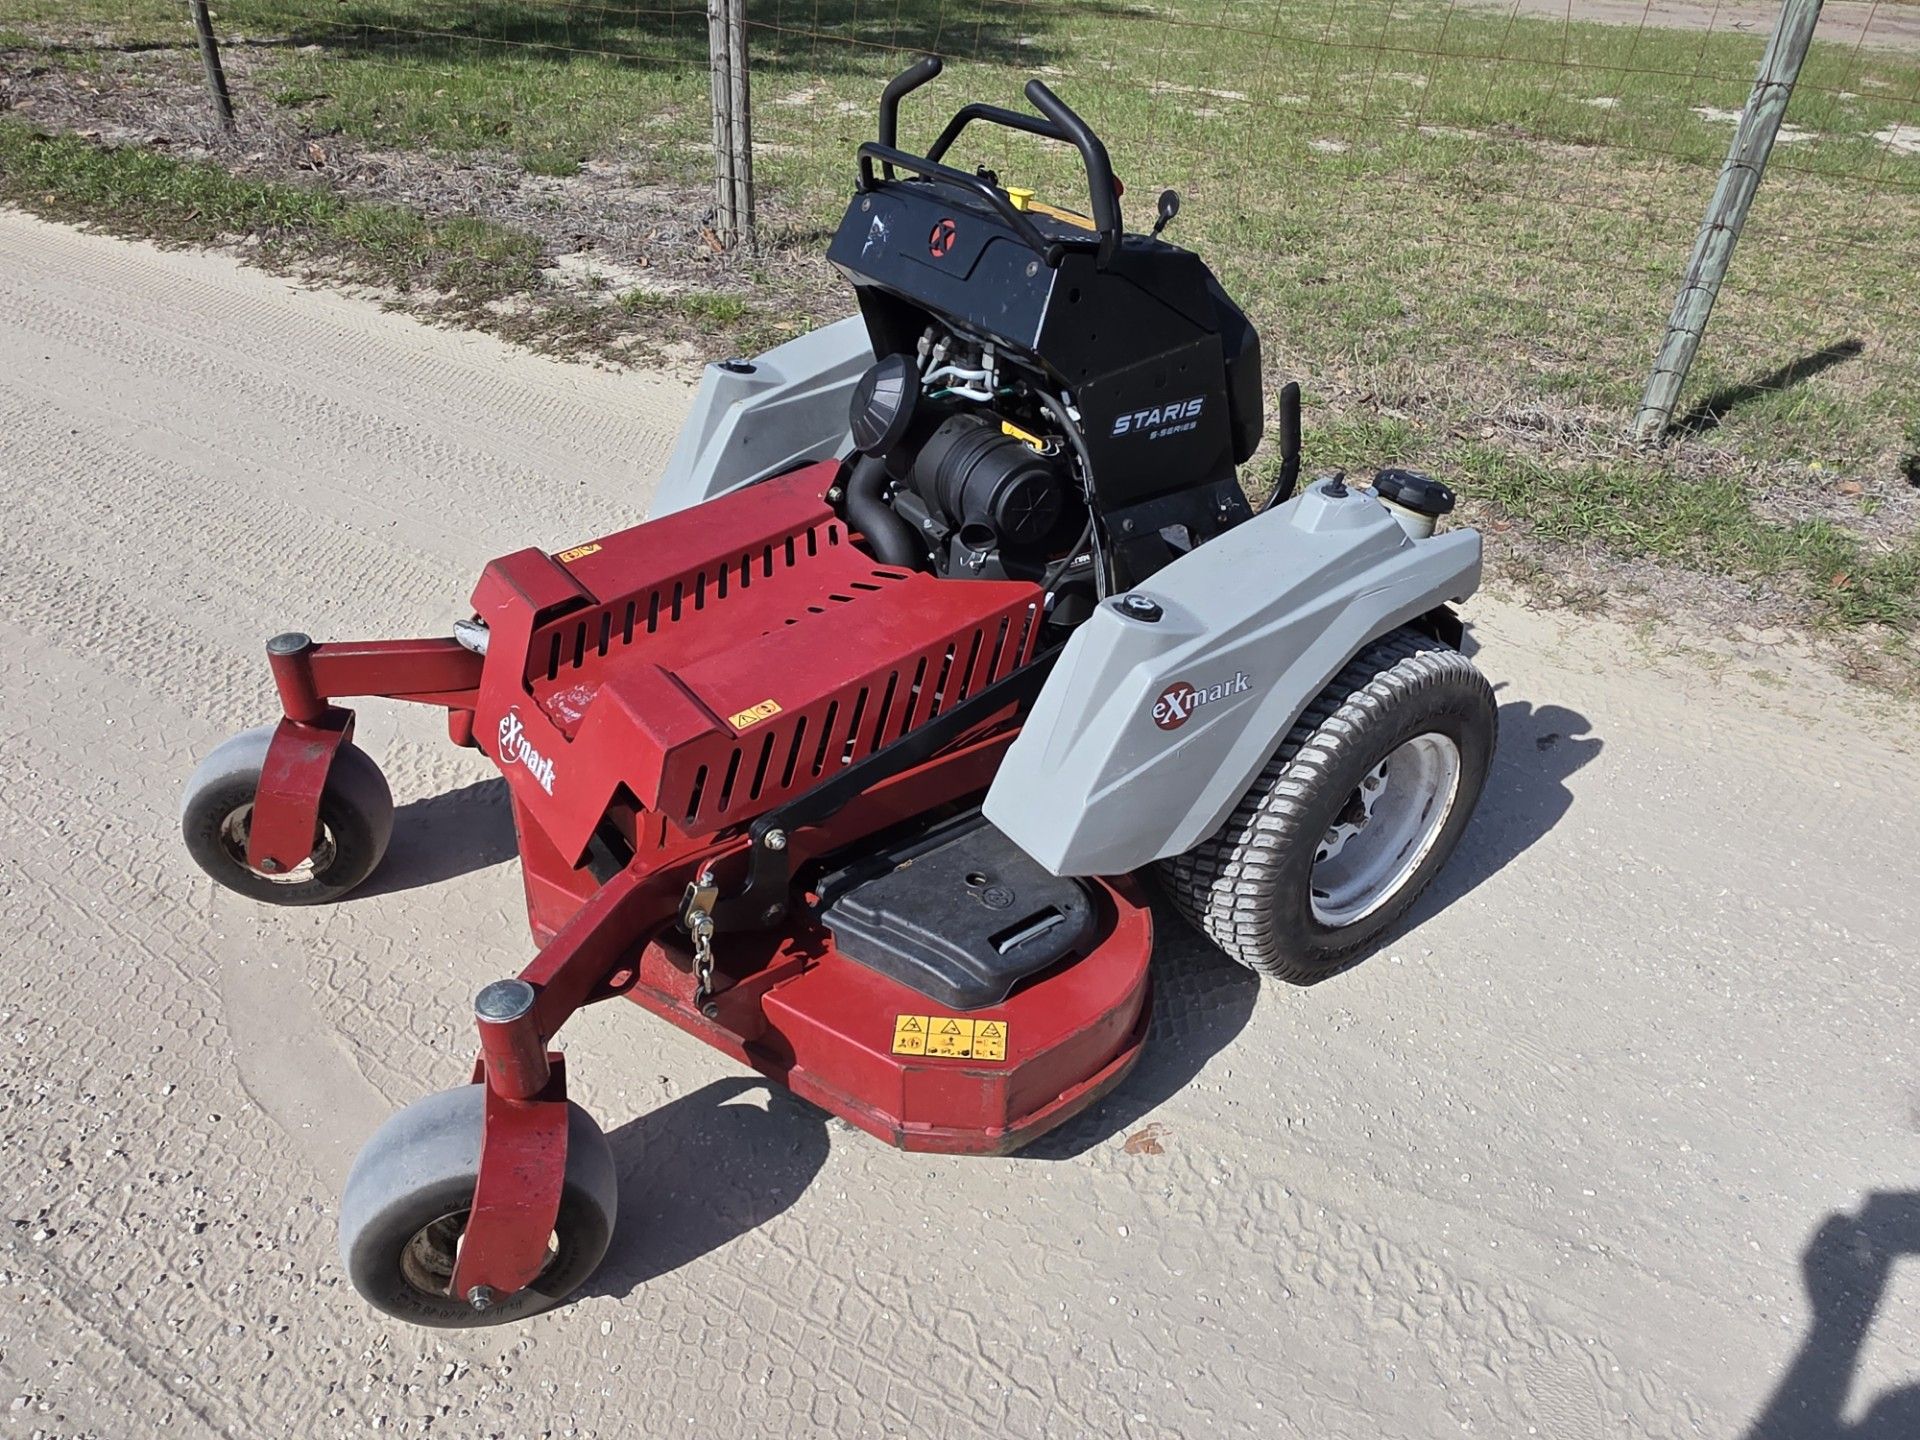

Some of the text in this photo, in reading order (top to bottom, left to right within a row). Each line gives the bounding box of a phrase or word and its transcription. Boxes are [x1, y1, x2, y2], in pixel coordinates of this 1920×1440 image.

[1112, 398, 1204, 435] STARIS
[1149, 421, 1198, 440] S-SERIES
[1151, 671, 1252, 725] eXmark
[498, 710, 556, 797] eXmark
